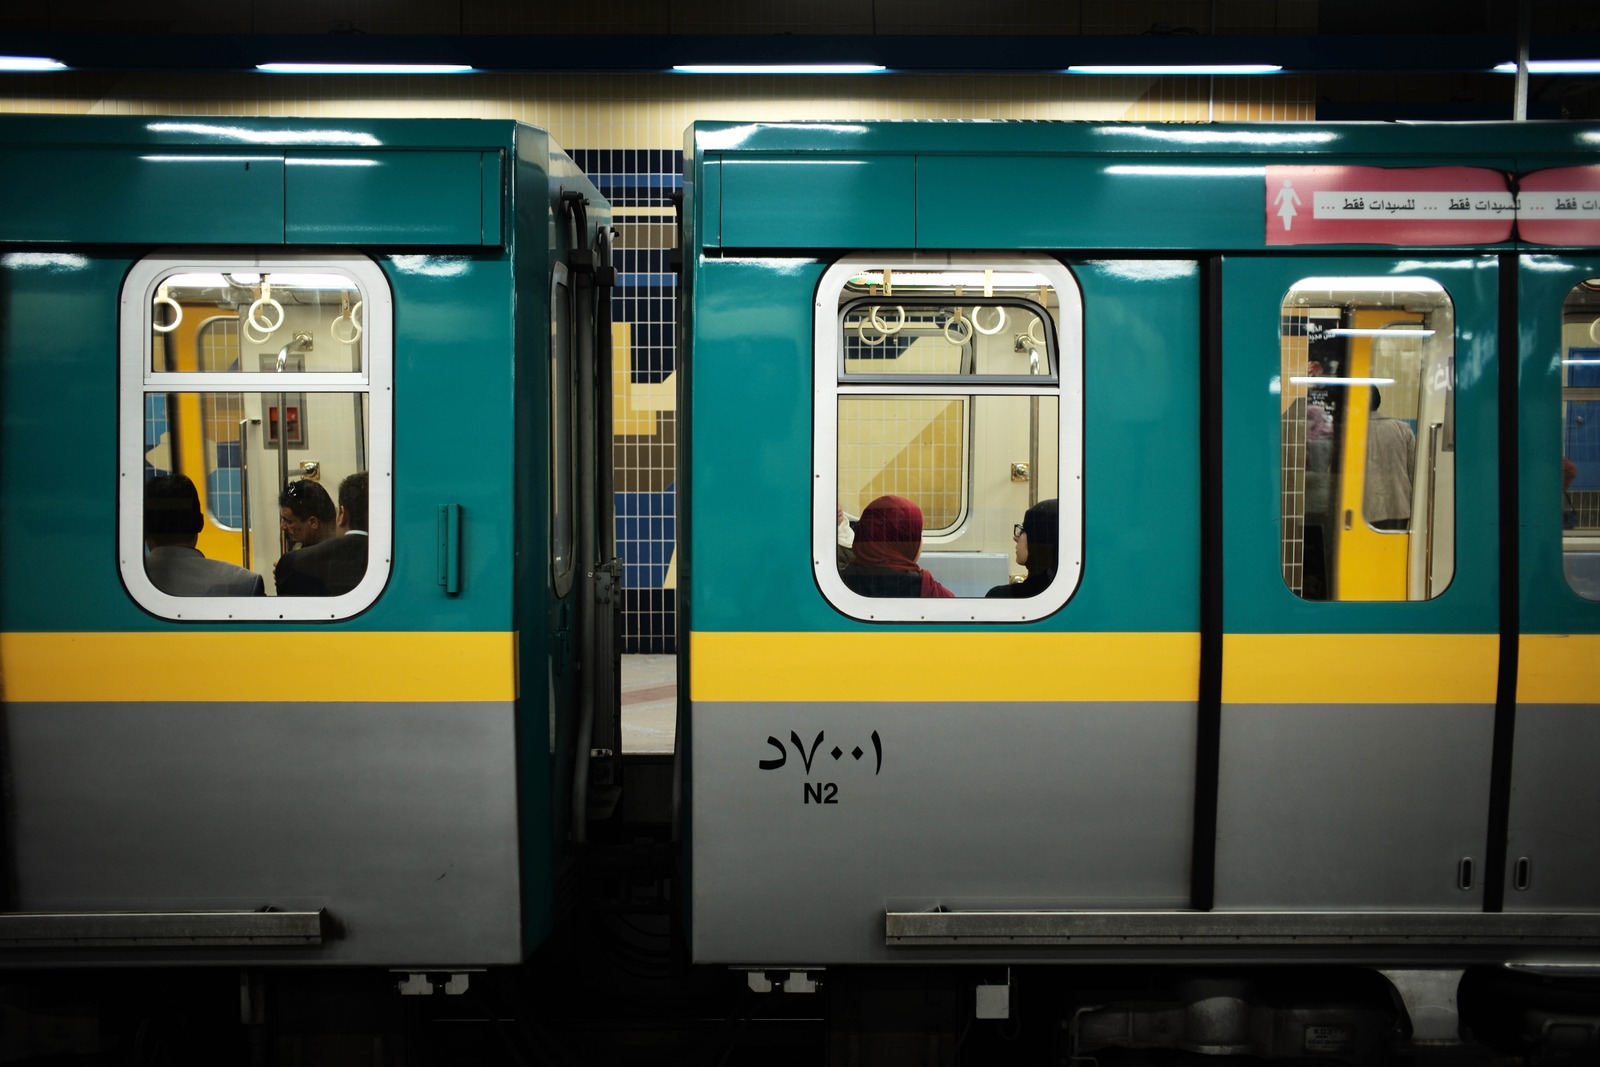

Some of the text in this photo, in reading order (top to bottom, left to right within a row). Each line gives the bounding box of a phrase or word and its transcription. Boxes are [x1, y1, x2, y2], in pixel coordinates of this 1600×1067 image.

[1342, 197, 1364, 210] فقط
[1369, 199, 1415, 213] للسيدات
[1448, 197, 1470, 210] فقط
[1555, 197, 1577, 210] فقط
[804, 783, 838, 804] N2
